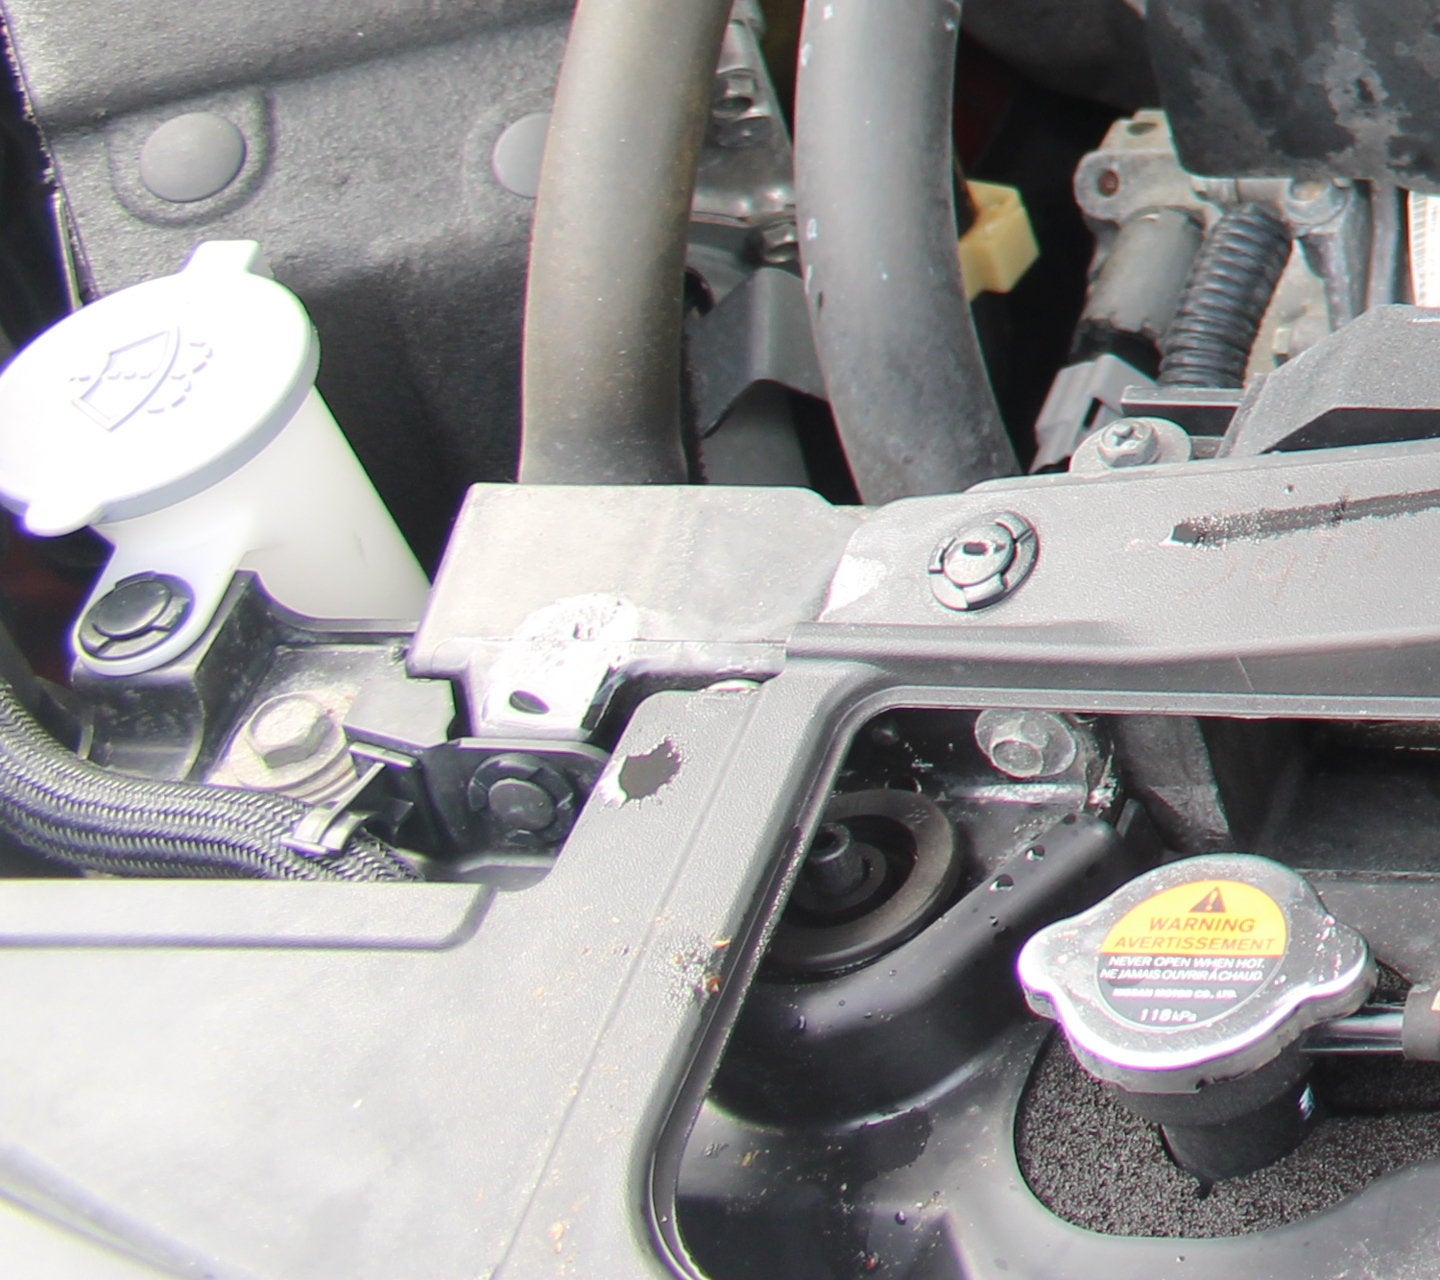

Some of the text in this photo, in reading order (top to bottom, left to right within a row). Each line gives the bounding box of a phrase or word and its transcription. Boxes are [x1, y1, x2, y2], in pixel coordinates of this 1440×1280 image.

[1149, 917, 1256, 933] WARNING
[1113, 936, 1275, 951] AVERTISSEMENT
[1108, 956, 1265, 969] NEVER OPEN WHEN HOT.
[1100, 967, 1264, 981] NE JAMAIS OUVRIR À CHAUD.
